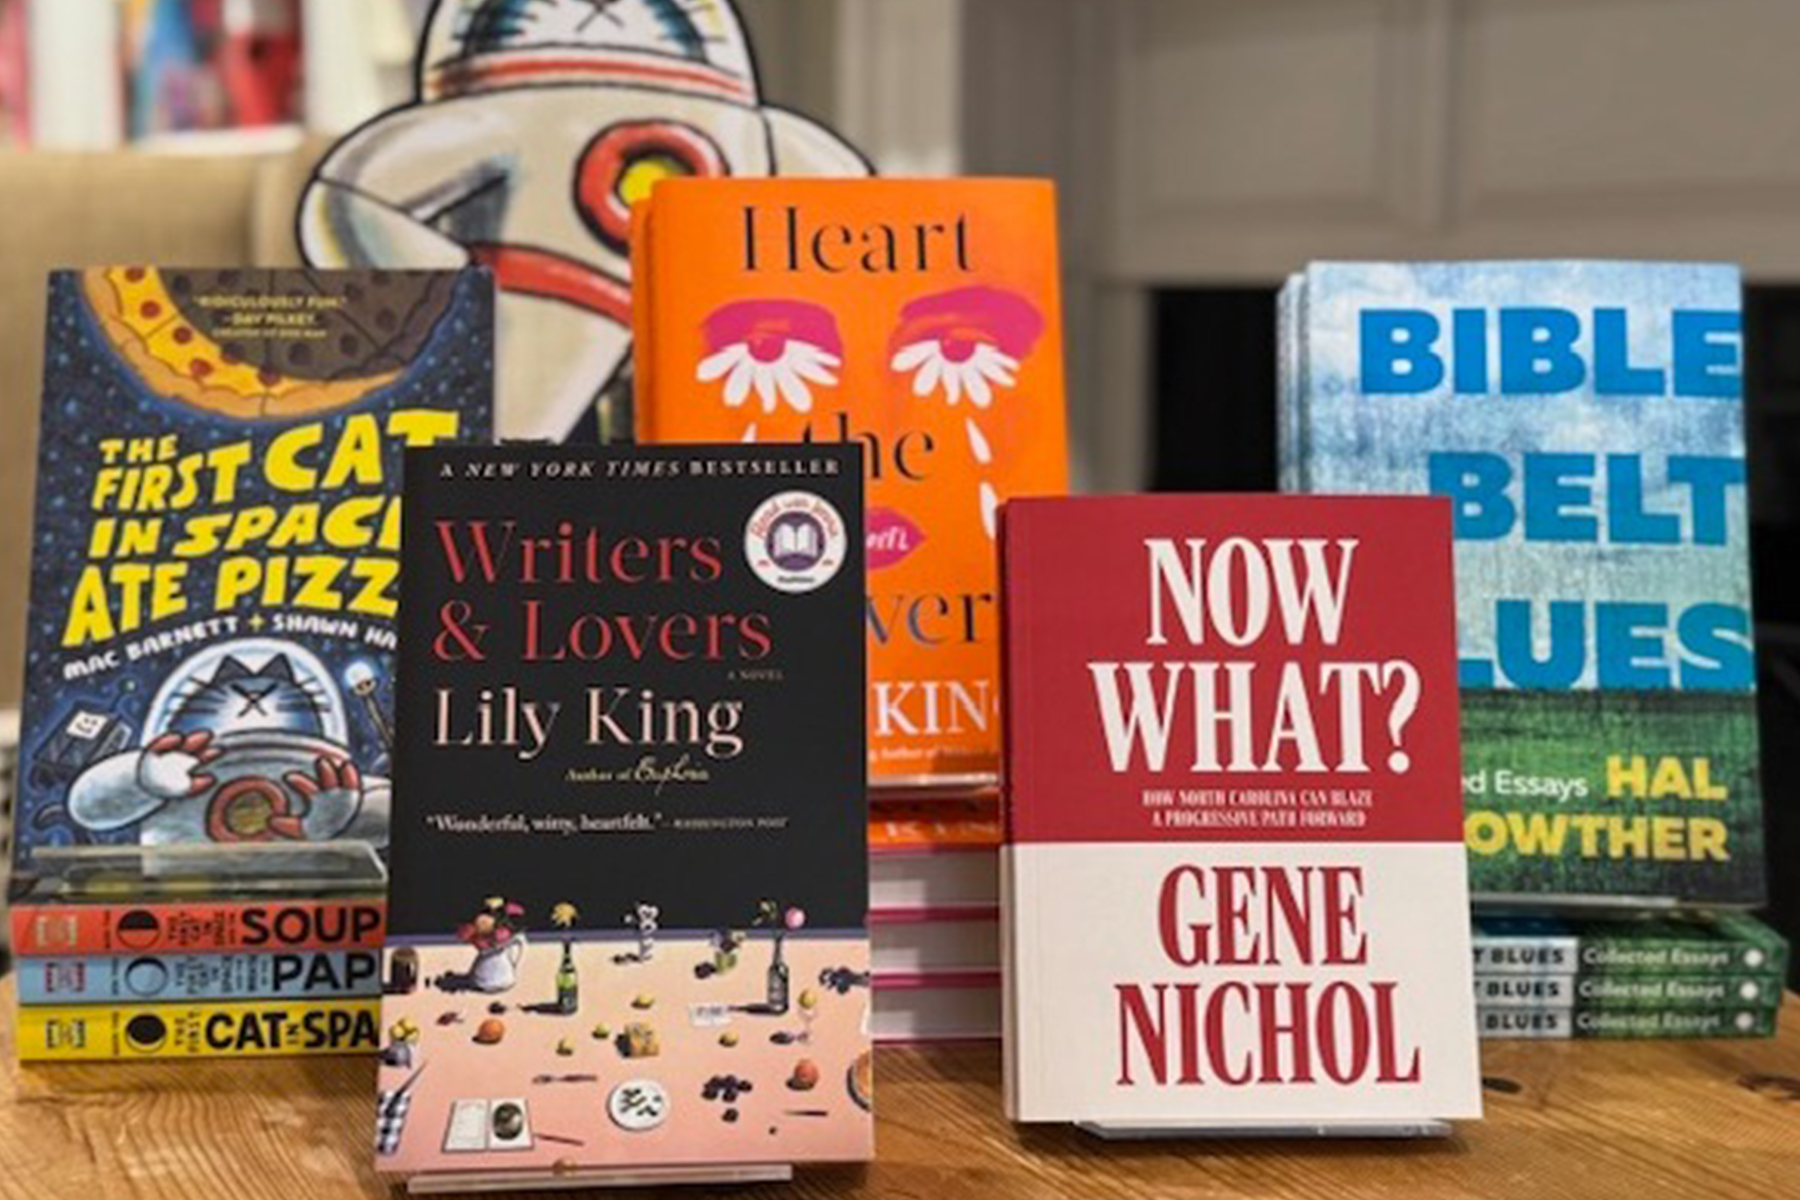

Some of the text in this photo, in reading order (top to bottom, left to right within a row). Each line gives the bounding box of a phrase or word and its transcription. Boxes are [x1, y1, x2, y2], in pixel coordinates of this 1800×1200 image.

[742, 206, 976, 274] Heart
[1359, 307, 1741, 398] BIBLE
[91, 408, 460, 512] FIRST CAT
[99, 435, 177, 464] THE
[440, 459, 840, 477] A NEW YORK TIMES BESTSELLER
[803, 412, 934, 481] he
[1428, 451, 1745, 546] BELT
[88, 518, 161, 558] IN
[435, 520, 722, 584] Writers
[61, 561, 188, 647] ATE
[1143, 537, 1359, 647] NOW
[63, 652, 119, 680] MAC
[126, 616, 238, 661] BARNETT
[272, 613, 358, 639] SHAWN
[433, 600, 773, 661] & Lovers
[1459, 600, 1755, 690] UES
[434, 688, 743, 759] Lily King
[872, 680, 999, 737] KIN
[1087, 659, 1421, 774] WHAT?
[1142, 790, 1373, 806] HOW NORTH CAROLINA CAN BLAZE
[1495, 769, 1588, 803] Essays
[1607, 755, 1728, 800] HAL
[1152, 811, 1367, 827] A PROGRESSIVE PATH FORWARD
[1464, 810, 1731, 860] OWTHER
[241, 906, 381, 945] SOUP
[1158, 864, 1368, 967] GENE
[272, 952, 377, 992] PAP
[1491, 947, 1565, 964] BLUES
[1583, 945, 1729, 969] Collected Essays
[1486, 981, 1559, 997] BLUES
[1579, 980, 1724, 1001] Collected Essays
[205, 1011, 287, 1049] CAT
[303, 1010, 379, 1048] SPA
[1114, 980, 1421, 1086] NICHOL
[1485, 1014, 1558, 1030] BLUES
[1577, 1011, 1720, 1033] Collected Essays
